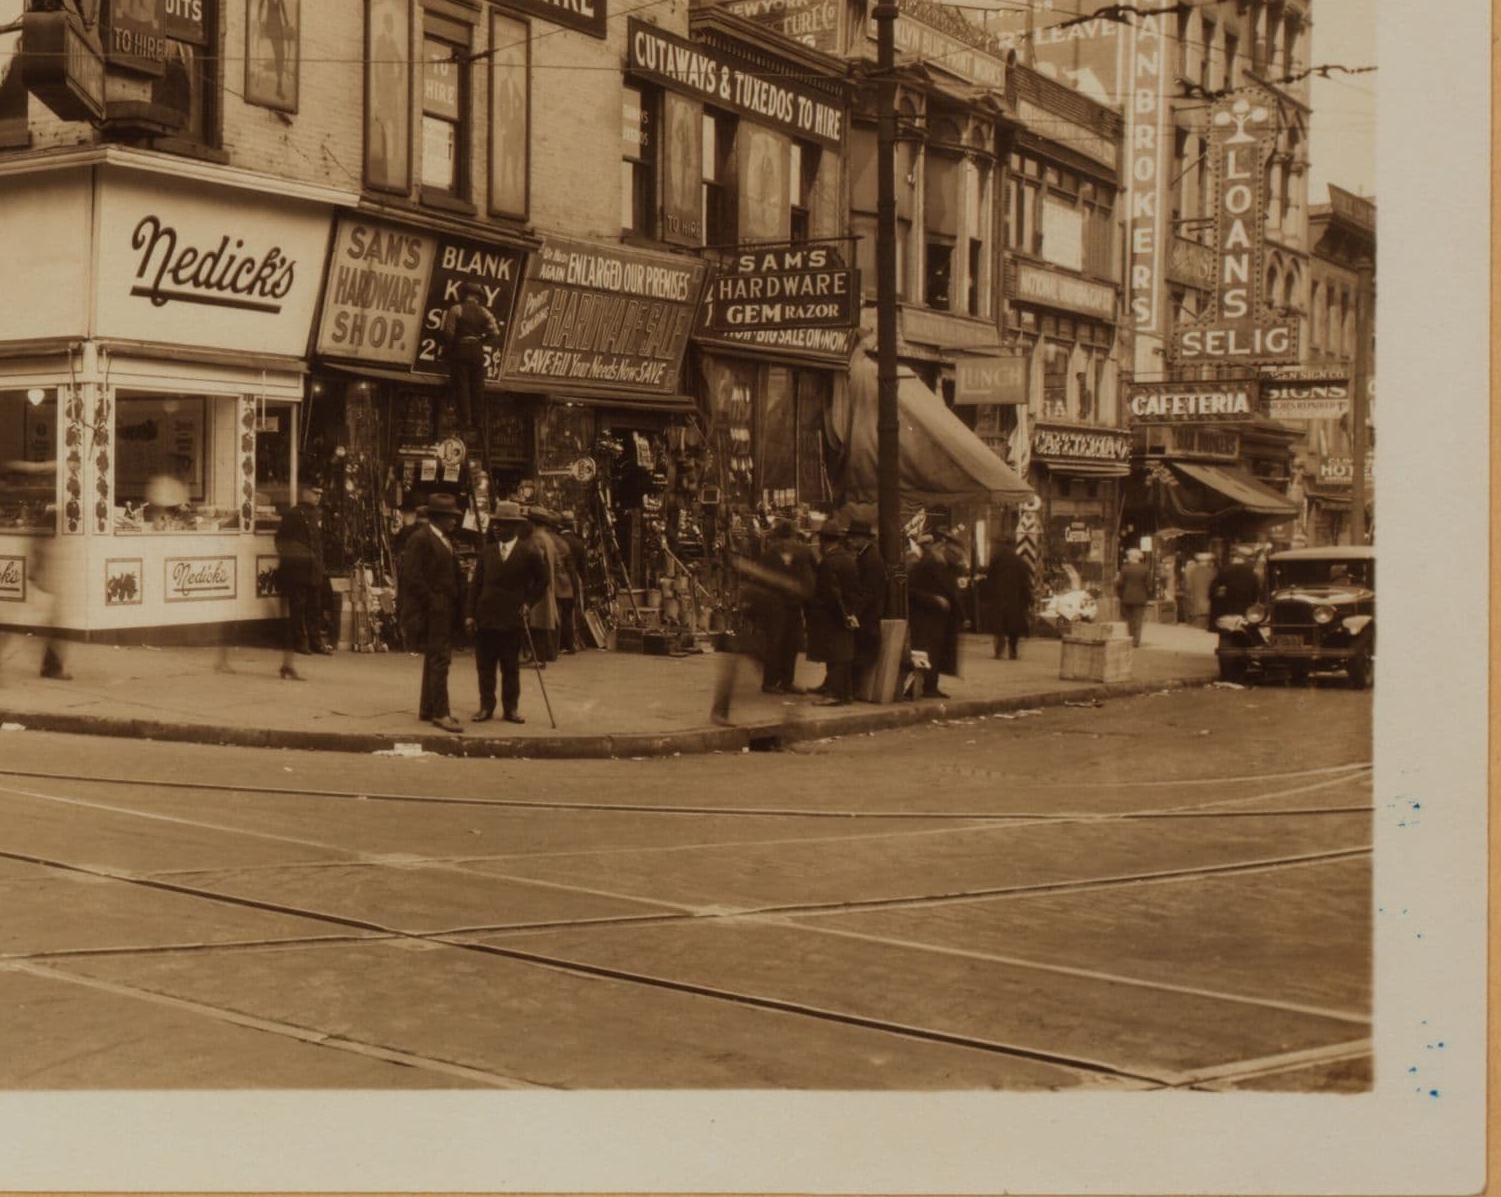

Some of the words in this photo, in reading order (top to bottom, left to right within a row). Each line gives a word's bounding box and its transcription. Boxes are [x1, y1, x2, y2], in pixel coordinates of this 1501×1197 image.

[113, 27, 131, 55] TO
[133, 33, 166, 63] HIRE
[425, 79, 455, 106] HIRE
[634, 31, 717, 93] CUTAWAYS
[720, 64, 732, 99] &
[733, 70, 794, 125] TUXEDOS
[797, 95, 813, 132] TO
[814, 102, 842, 142] HIRE
[666, 214, 679, 233] TO
[682, 219, 702, 238] HIRE
[1222, 150, 1253, 319] LOANS
[130, 214, 296, 313] Nedick's
[346, 225, 423, 270] SAM'S
[441, 245, 516, 282] BLANK
[737, 249, 829, 273] SAM'S
[332, 265, 423, 316] HARDWARE
[538, 263, 567, 283] AGAIN
[566, 251, 623, 292] ENLARGED
[623, 262, 644, 294] OUR
[644, 265, 691, 302] PREMISES
[719, 272, 848, 301] HARDWARE
[443, 278, 501, 308] KY
[541, 287, 647, 356] HARDWARE
[638, 302, 689, 360] SALE
[725, 302, 783, 325] GEM
[783, 303, 841, 320] RAZOR
[331, 309, 406, 351] SHOP.
[778, 328, 805, 350] SALE
[1180, 326, 1291, 358] SELIG
[636, 360, 668, 385] SAVE
[960, 365, 1023, 396] LUNCH
[1131, 392, 1252, 417] CAFETERIA
[1267, 385, 1349, 400] SIGNS
[172, 561, 232, 597] Nedick's
